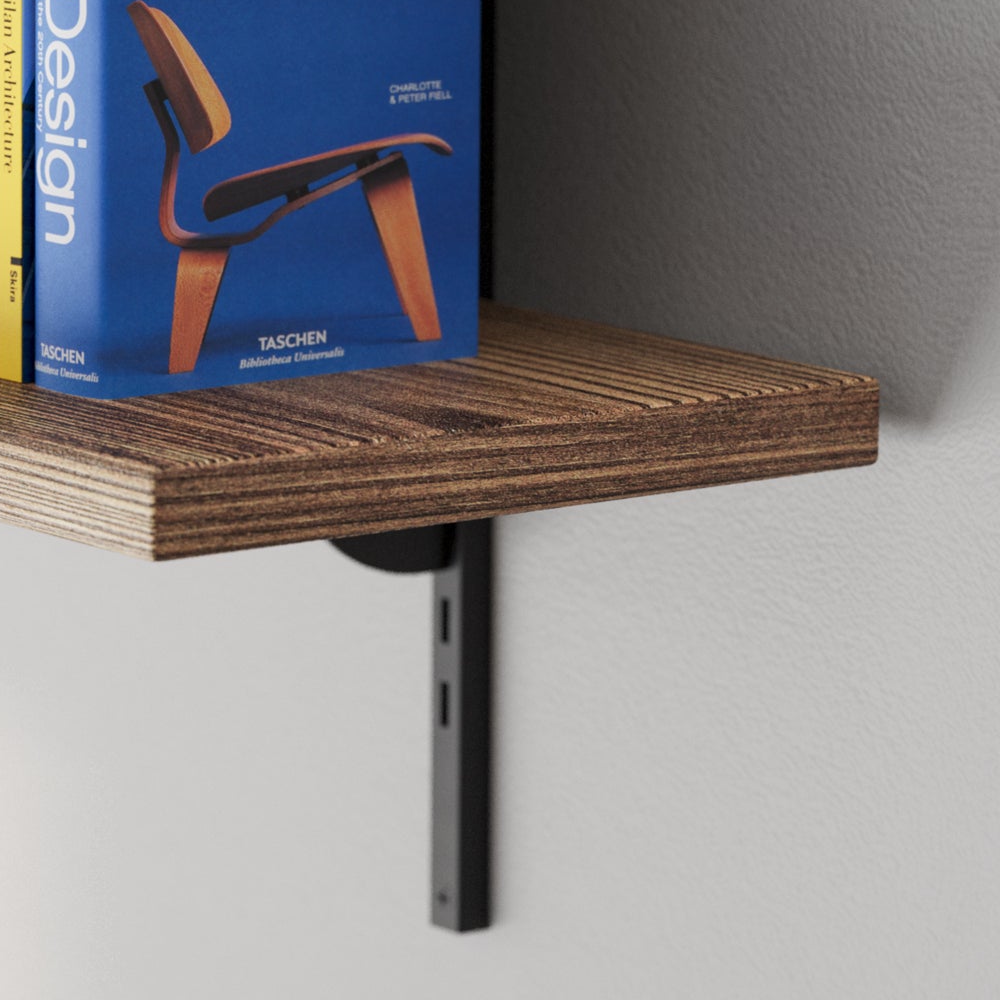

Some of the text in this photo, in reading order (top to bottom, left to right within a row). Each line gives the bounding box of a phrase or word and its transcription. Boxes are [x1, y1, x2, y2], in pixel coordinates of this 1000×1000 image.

[389, 80, 441, 93] CHARLOTTE
[398, 92, 426, 103] PETER
[429, 91, 452, 100] FIELL
[3, 43, 17, 174] Architecture
[36, 71, 44, 132] Century
[258, 329, 328, 351] TASCHEN
[40, 342, 85, 365] TASCHEN
[239, 346, 345, 369] Bibliotheca Universalis
[60, 367, 99, 383] Universalis
